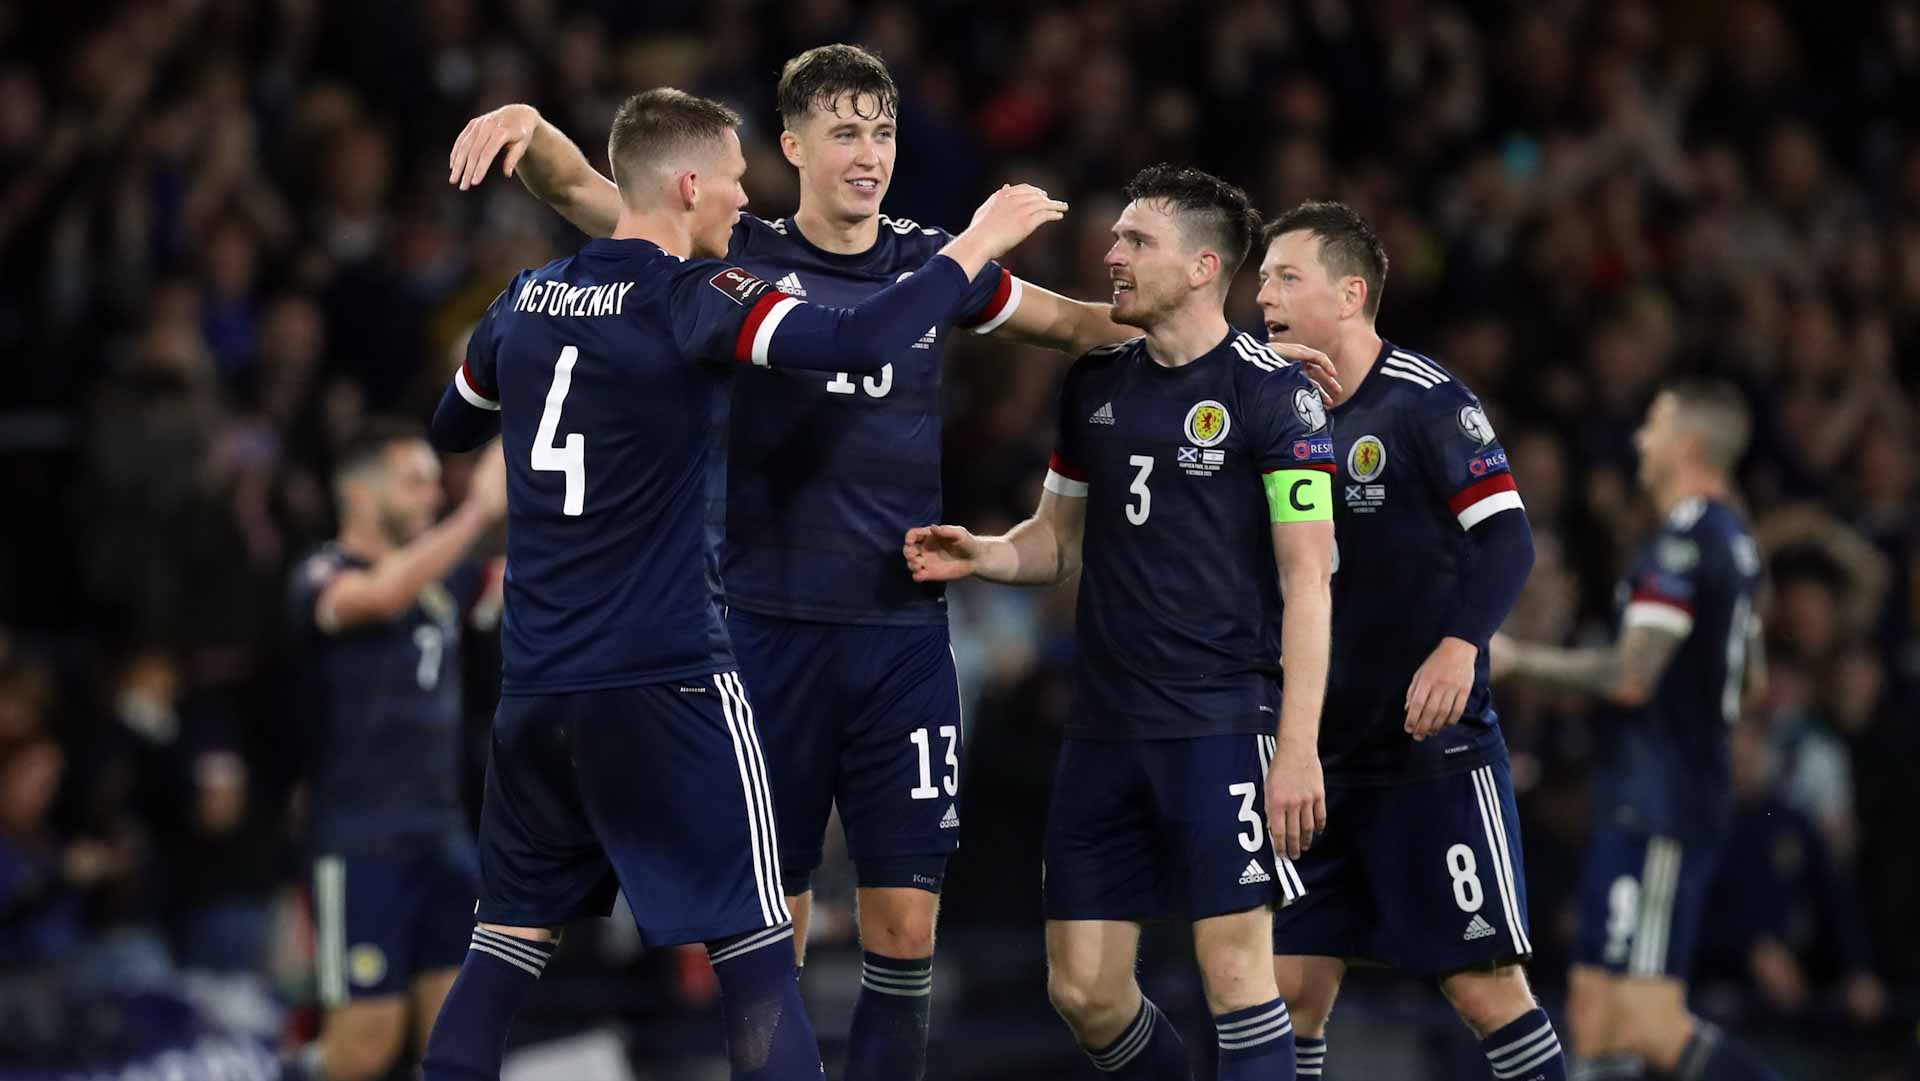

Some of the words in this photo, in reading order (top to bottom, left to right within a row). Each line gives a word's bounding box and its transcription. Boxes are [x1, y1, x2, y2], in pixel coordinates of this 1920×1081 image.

[775, 285, 807, 298] didas
[530, 345, 586, 517] 4
[1125, 454, 1155, 526] 3
[1289, 479, 1315, 511] C
[909, 725, 960, 800] 13
[1228, 781, 1265, 853] 3
[1238, 873, 1271, 885] adidas
[1445, 842, 1485, 913] 8
[1463, 926, 1496, 941] adidas
